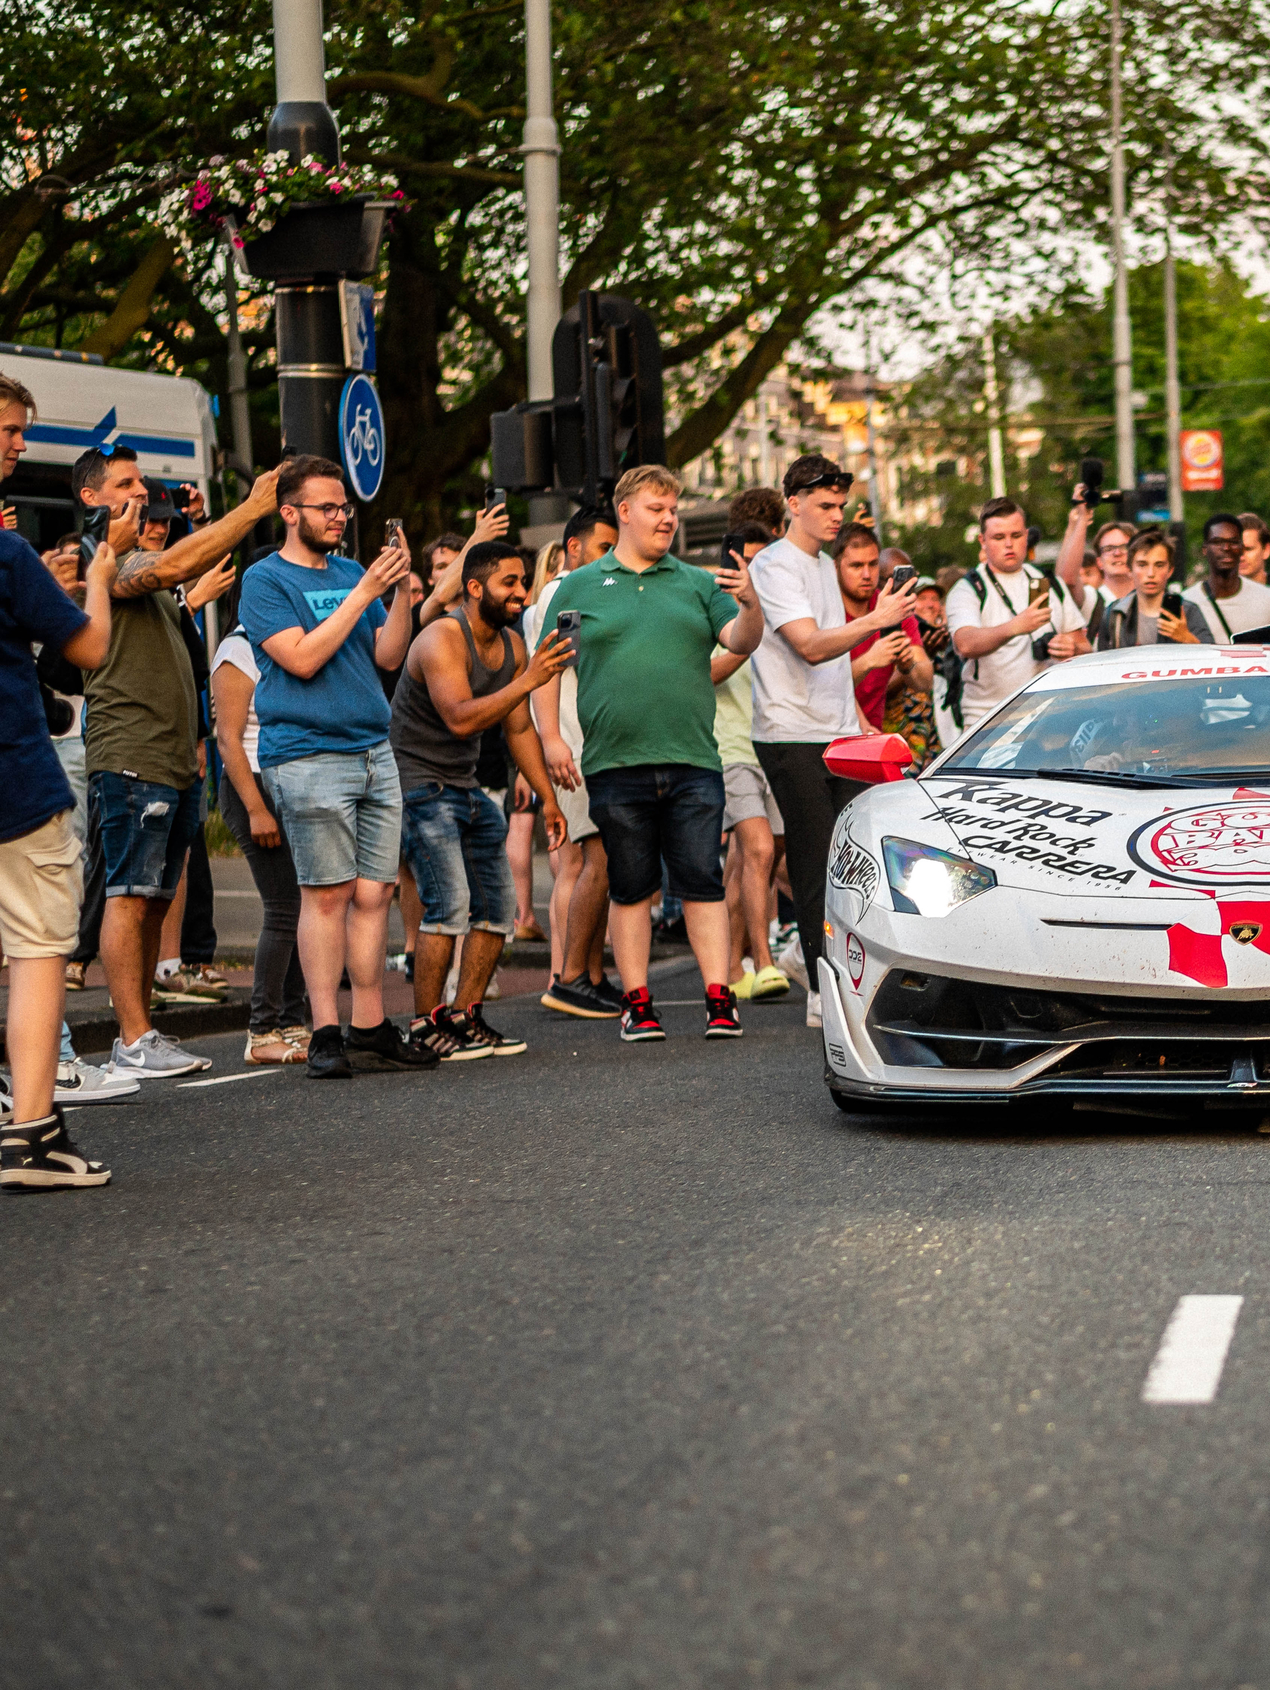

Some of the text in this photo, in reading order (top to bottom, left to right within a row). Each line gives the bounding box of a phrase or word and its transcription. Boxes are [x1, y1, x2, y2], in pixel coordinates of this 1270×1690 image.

[933, 781, 1113, 827] Kappa
[920, 807, 1098, 855] Hard Rock
[958, 835, 1137, 884] CARRERA
[1028, 865, 1075, 882] SINCE
